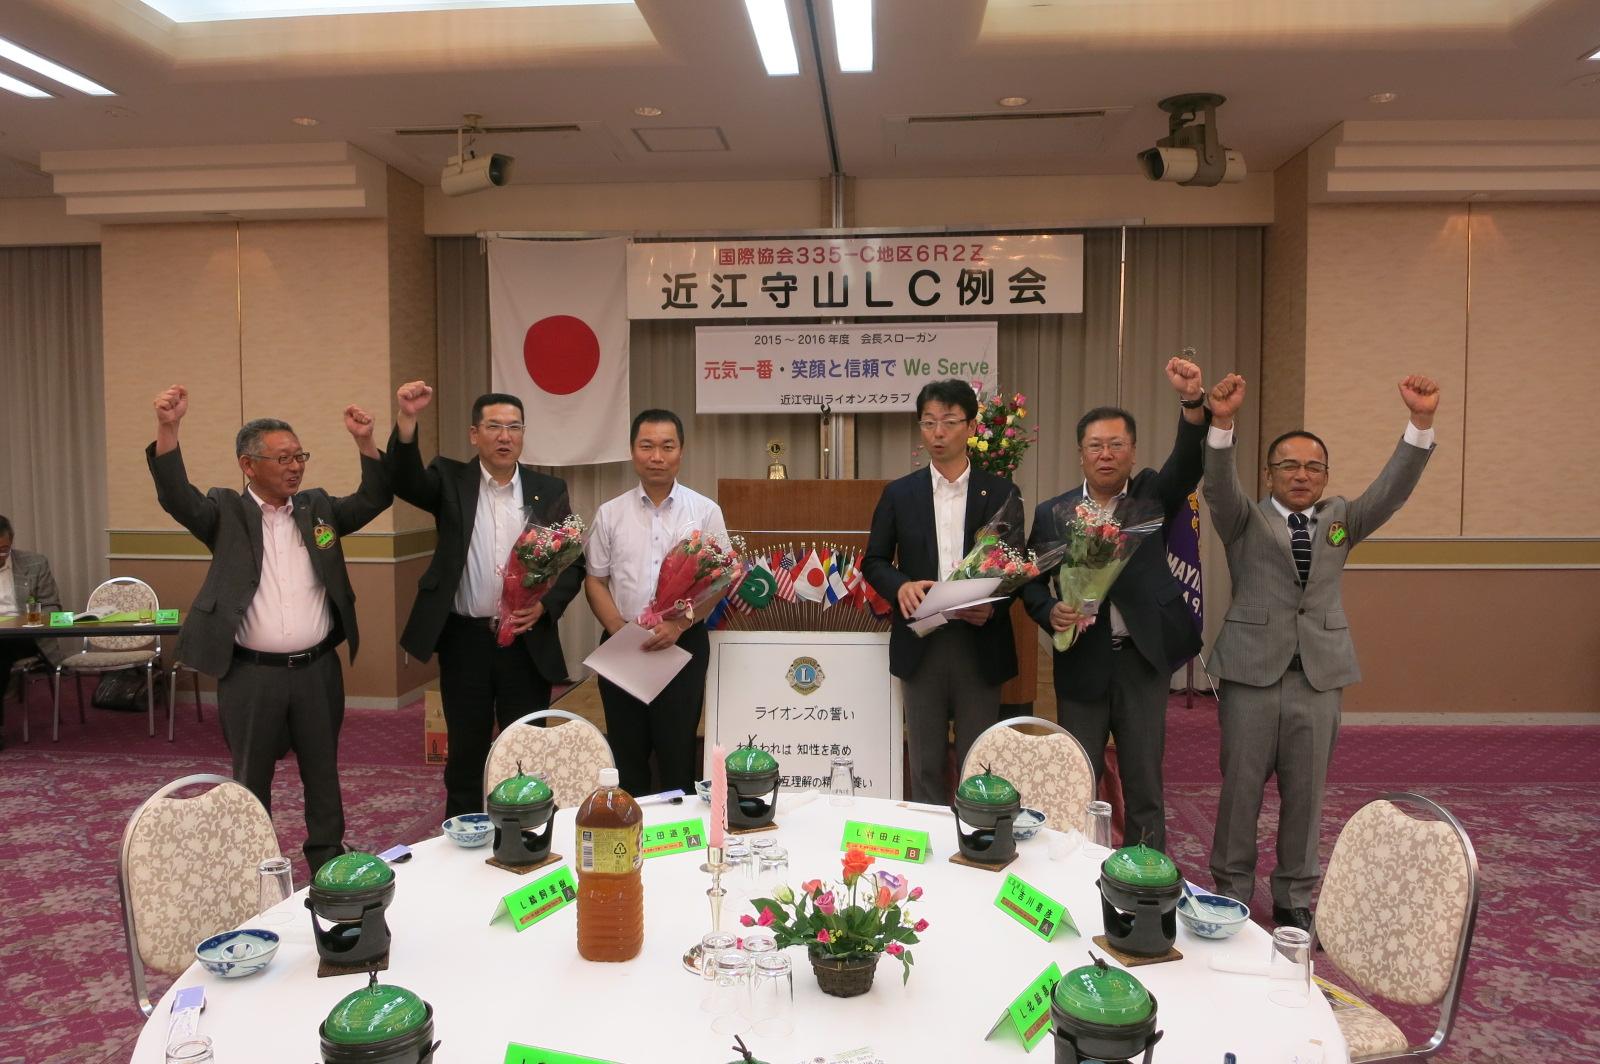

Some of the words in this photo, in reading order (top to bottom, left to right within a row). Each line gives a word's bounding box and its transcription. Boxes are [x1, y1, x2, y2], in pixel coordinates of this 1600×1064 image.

[660, 266, 1048, 311] 近江守山LC例会
[860, 332, 938, 345] 会長スローガン
[903, 358, 931, 376] We
[937, 357, 990, 376] Serve
[780, 392, 911, 406] 近江守山ライオンズクラブ
[800, 667, 812, 683] L
[755, 704, 855, 721] ライオンズの誓い
[796, 742, 852, 757] 知性を高め
